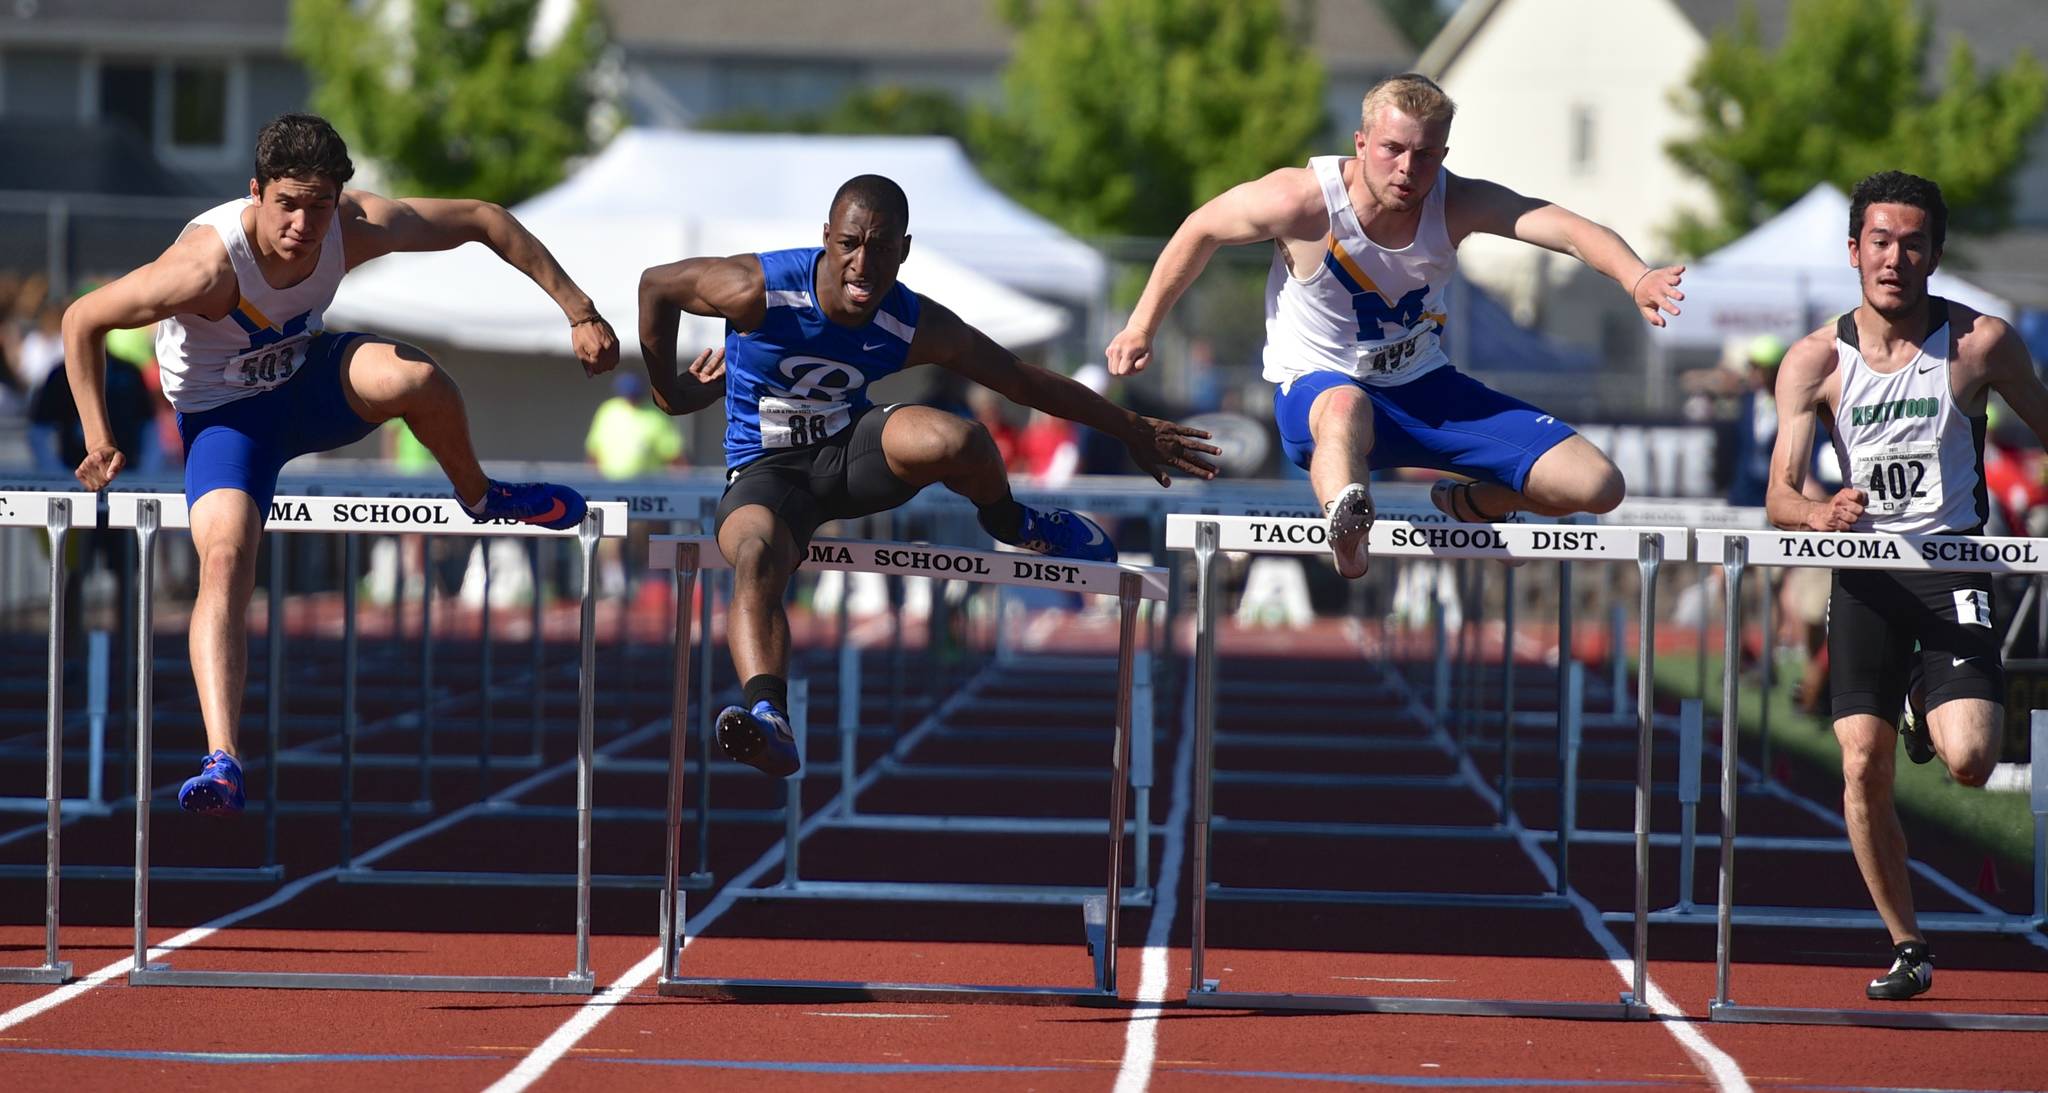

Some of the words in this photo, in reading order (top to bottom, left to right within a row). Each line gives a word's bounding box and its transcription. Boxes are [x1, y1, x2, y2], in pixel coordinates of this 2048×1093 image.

[241, 347, 294, 386] 503
[1870, 460, 1927, 500] 402
[334, 503, 449, 523] SCHOOL
[1250, 523, 1326, 544] TACO
[1392, 528, 1508, 549] SCHOOL
[1532, 531, 1606, 551] DIST.
[1780, 538, 1901, 559] TACOMA
[1921, 541, 2038, 563] SCHOOL
[874, 550, 990, 574] SCHOOL
[1013, 561, 1087, 584] DIST.
[1965, 590, 1982, 623] 1
